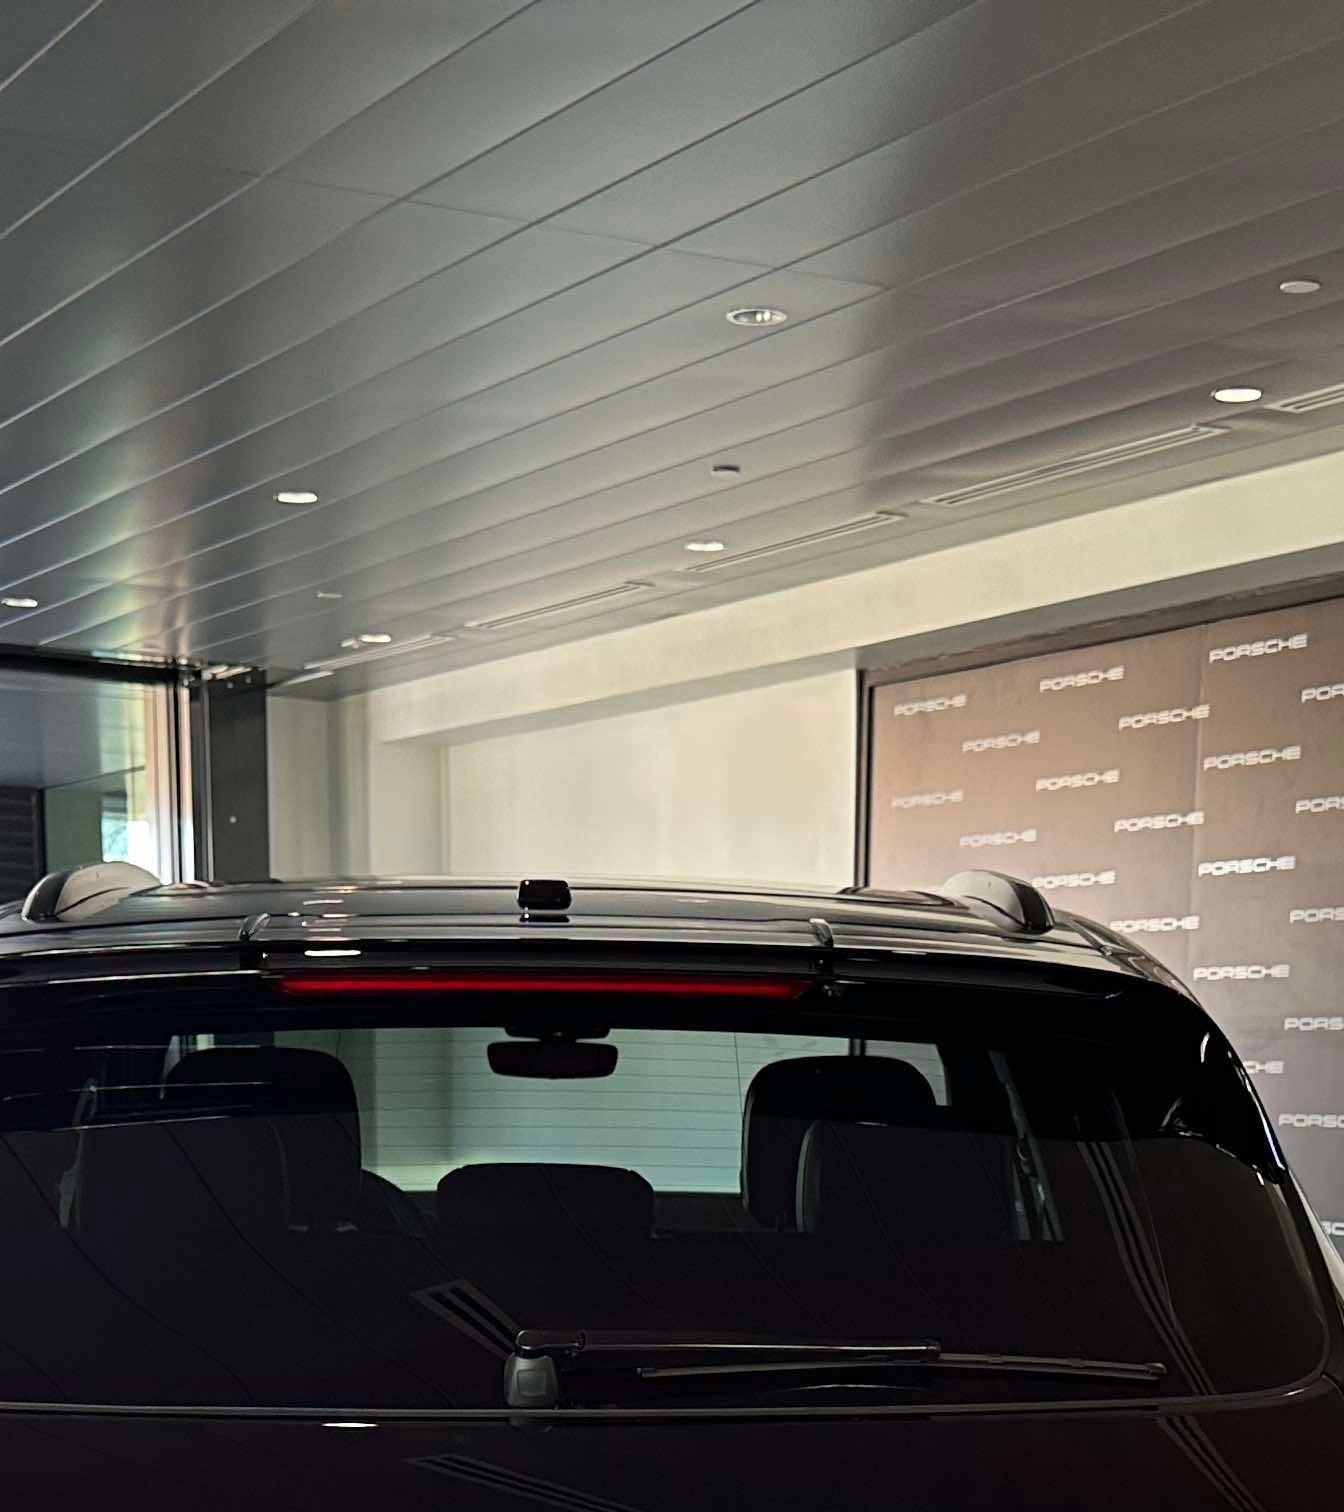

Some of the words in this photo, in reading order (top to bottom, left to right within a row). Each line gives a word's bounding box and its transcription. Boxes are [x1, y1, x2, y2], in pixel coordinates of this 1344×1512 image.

[1209, 634, 1307, 663] PORSCHE
[1040, 666, 1124, 692] PORSCHE
[894, 694, 966, 716] PORSCHE
[1119, 704, 1210, 730] PORSCHE
[962, 730, 1040, 753] PORSCHE
[1204, 745, 1301, 770] PORSCHE
[1036, 769, 1119, 792] PORSCHE
[892, 789, 963, 808] PORSCHE
[1115, 811, 1204, 832] PORSCHE
[960, 829, 1036, 847] PORSCHE
[1198, 856, 1296, 877] PORSCHE
[1110, 915, 1199, 933] PORSCHE
[1193, 964, 1290, 980] PORSCHE
